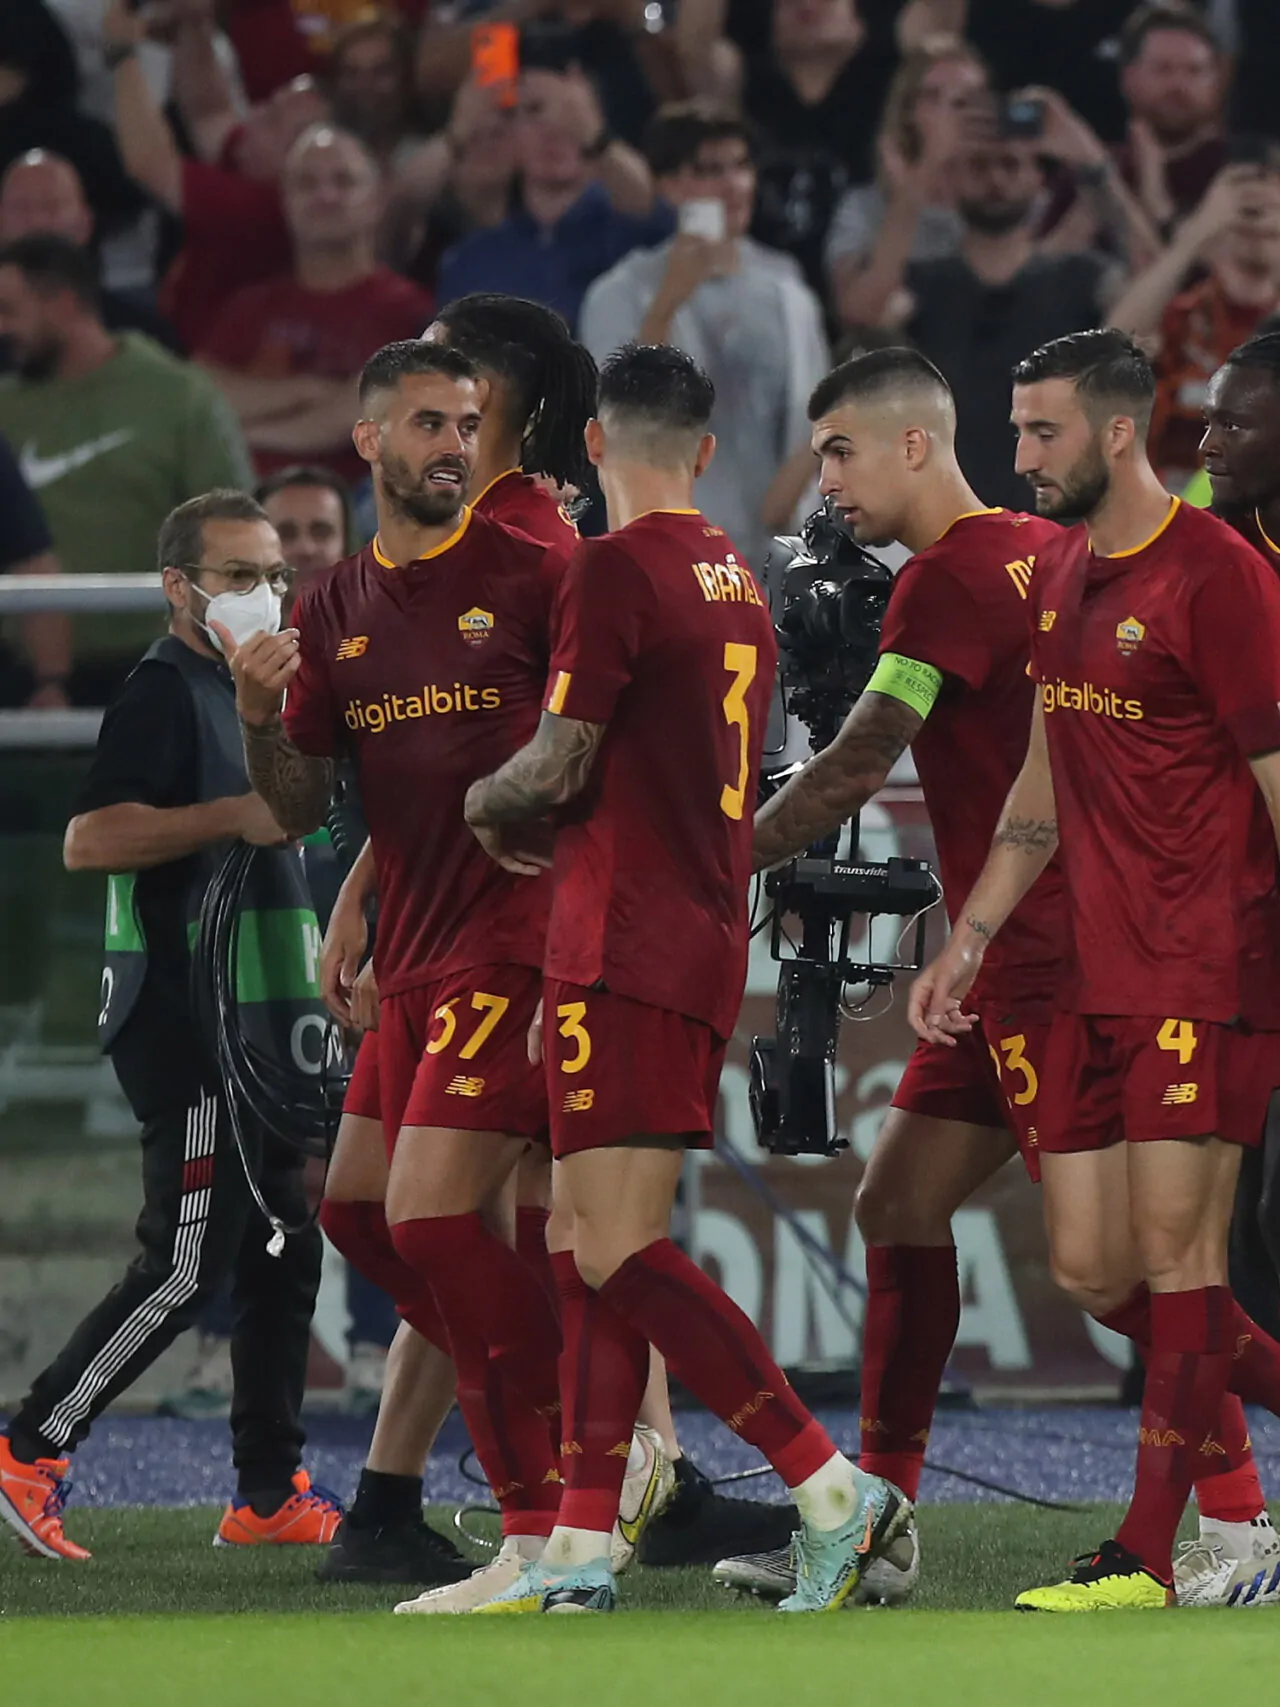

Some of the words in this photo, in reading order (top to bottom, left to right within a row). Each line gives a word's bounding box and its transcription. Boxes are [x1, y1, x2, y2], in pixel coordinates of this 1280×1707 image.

[463, 631, 490, 641] ROMA
[344, 682, 501, 733] digitalbits
[1025, 660, 1144, 720] gitalbits
[720, 642, 758, 821] 3
[833, 864, 889, 878] transvide
[556, 1001, 592, 1074] 3
[1156, 1018, 1197, 1065] 4
